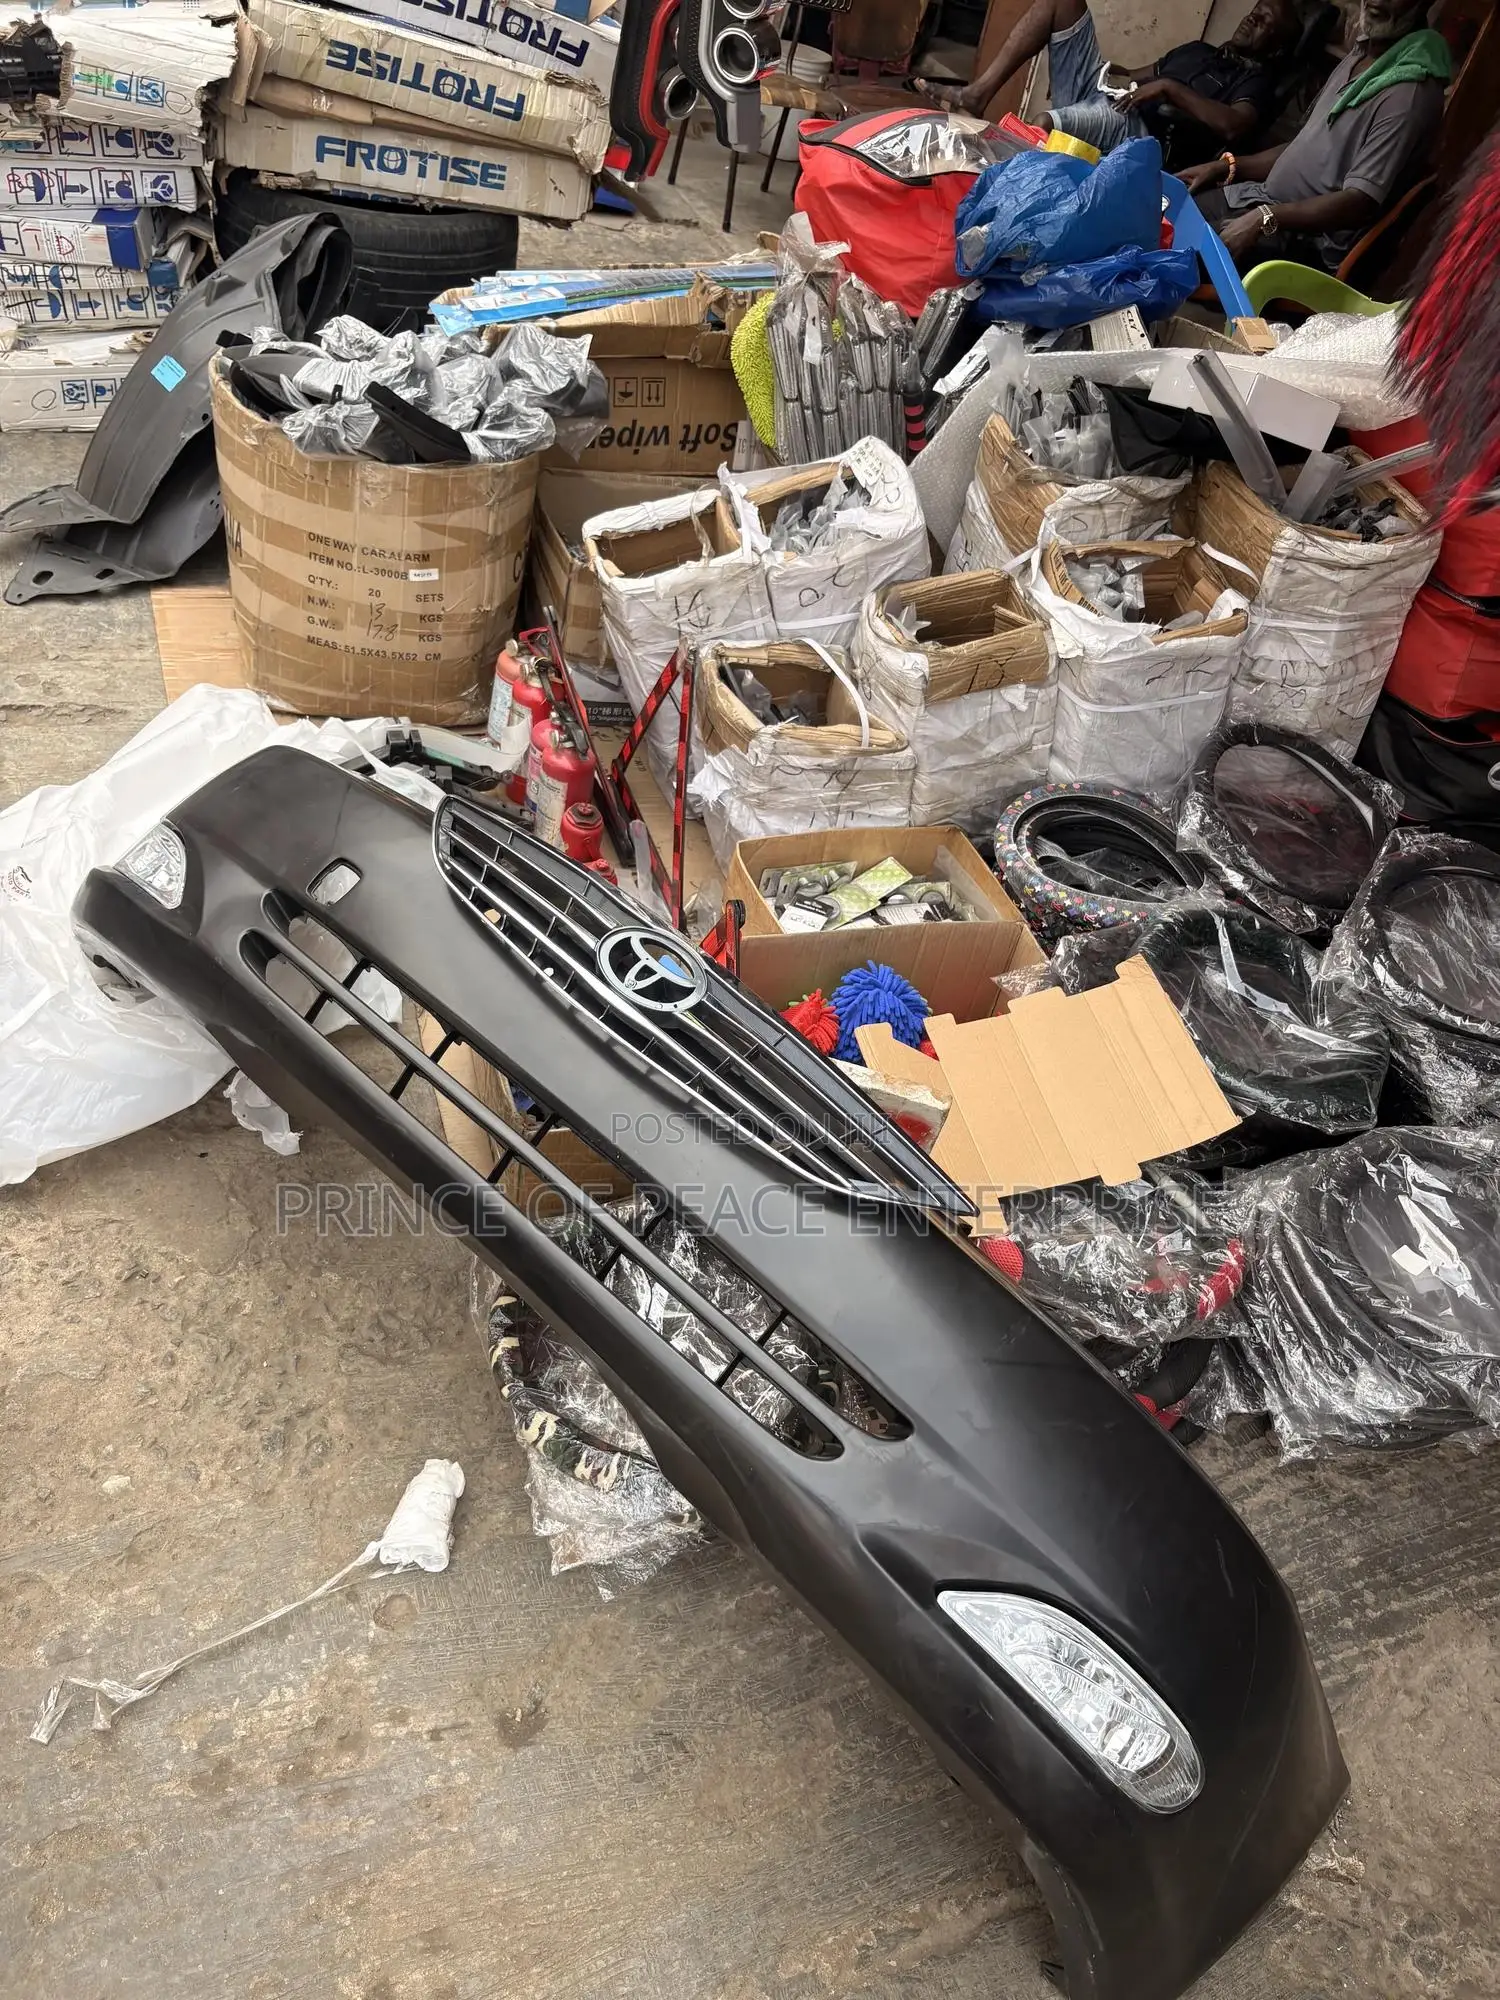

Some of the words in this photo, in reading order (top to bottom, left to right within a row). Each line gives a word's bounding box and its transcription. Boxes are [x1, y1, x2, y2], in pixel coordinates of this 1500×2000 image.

[397, 0, 589, 68] FROTIS
[326, 39, 526, 122] FROTISE
[315, 135, 507, 191] FROTISE
[679, 422, 739, 452] Soft
[308, 532, 331, 547] ONE
[333, 538, 357, 553] WAY
[361, 547, 386, 559] CAR
[388, 552, 430, 562] ALARM
[308, 552, 334, 566] ITEM
[368, 588, 381, 598] 20
[415, 593, 444, 603] SETS
[420, 614, 443, 623] KGS
[418, 634, 442, 643] KGS
[424, 653, 441, 661] CM
